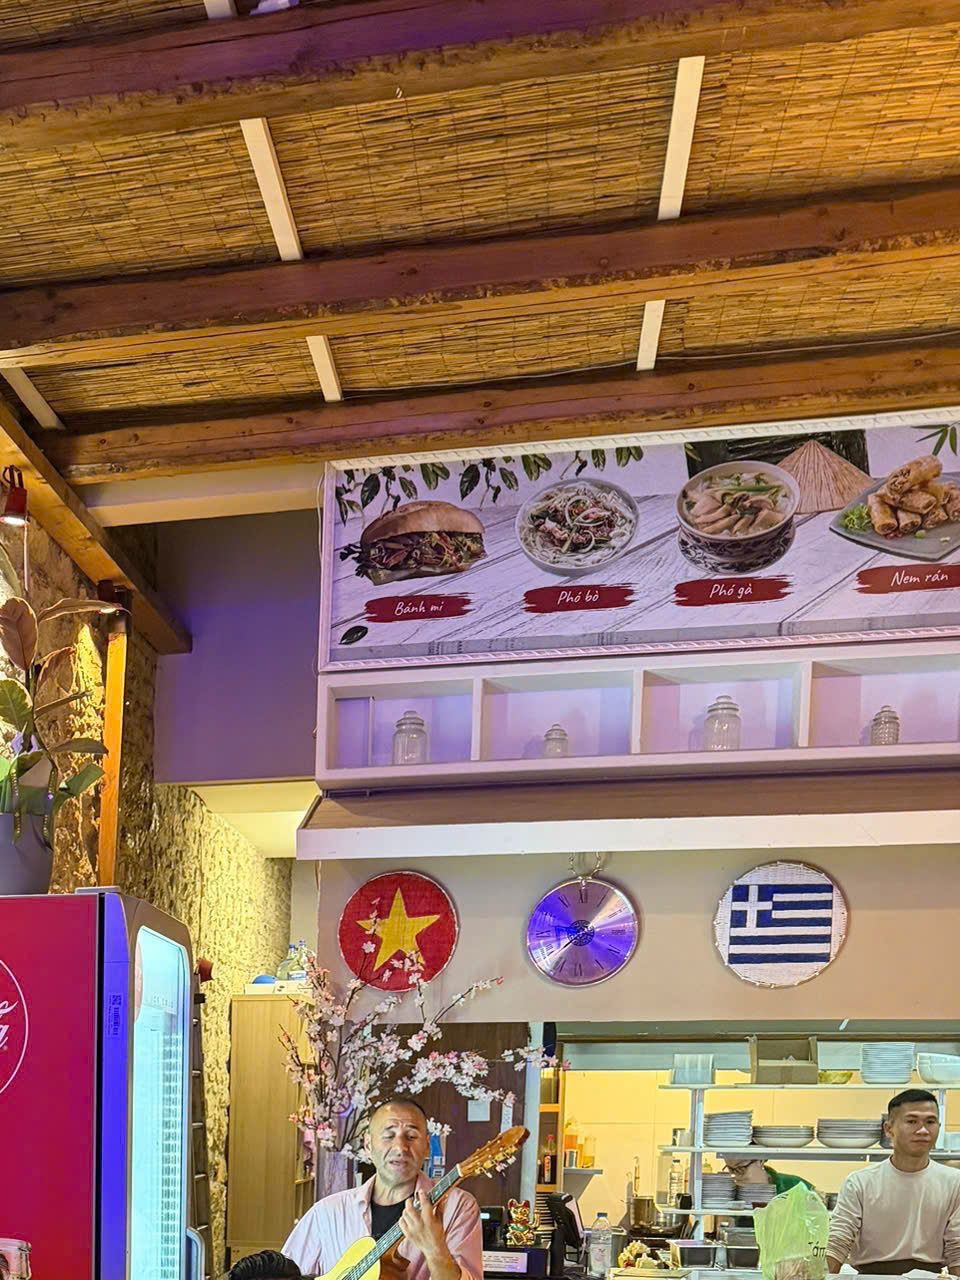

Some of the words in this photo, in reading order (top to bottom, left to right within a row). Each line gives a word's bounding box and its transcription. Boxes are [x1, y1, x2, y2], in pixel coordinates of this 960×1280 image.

[891, 570, 921, 587] Nem
[925, 569, 949, 582] rán
[585, 590, 600, 602] bò
[738, 584, 753, 600] gà
[394, 600, 426, 616] Bánh
